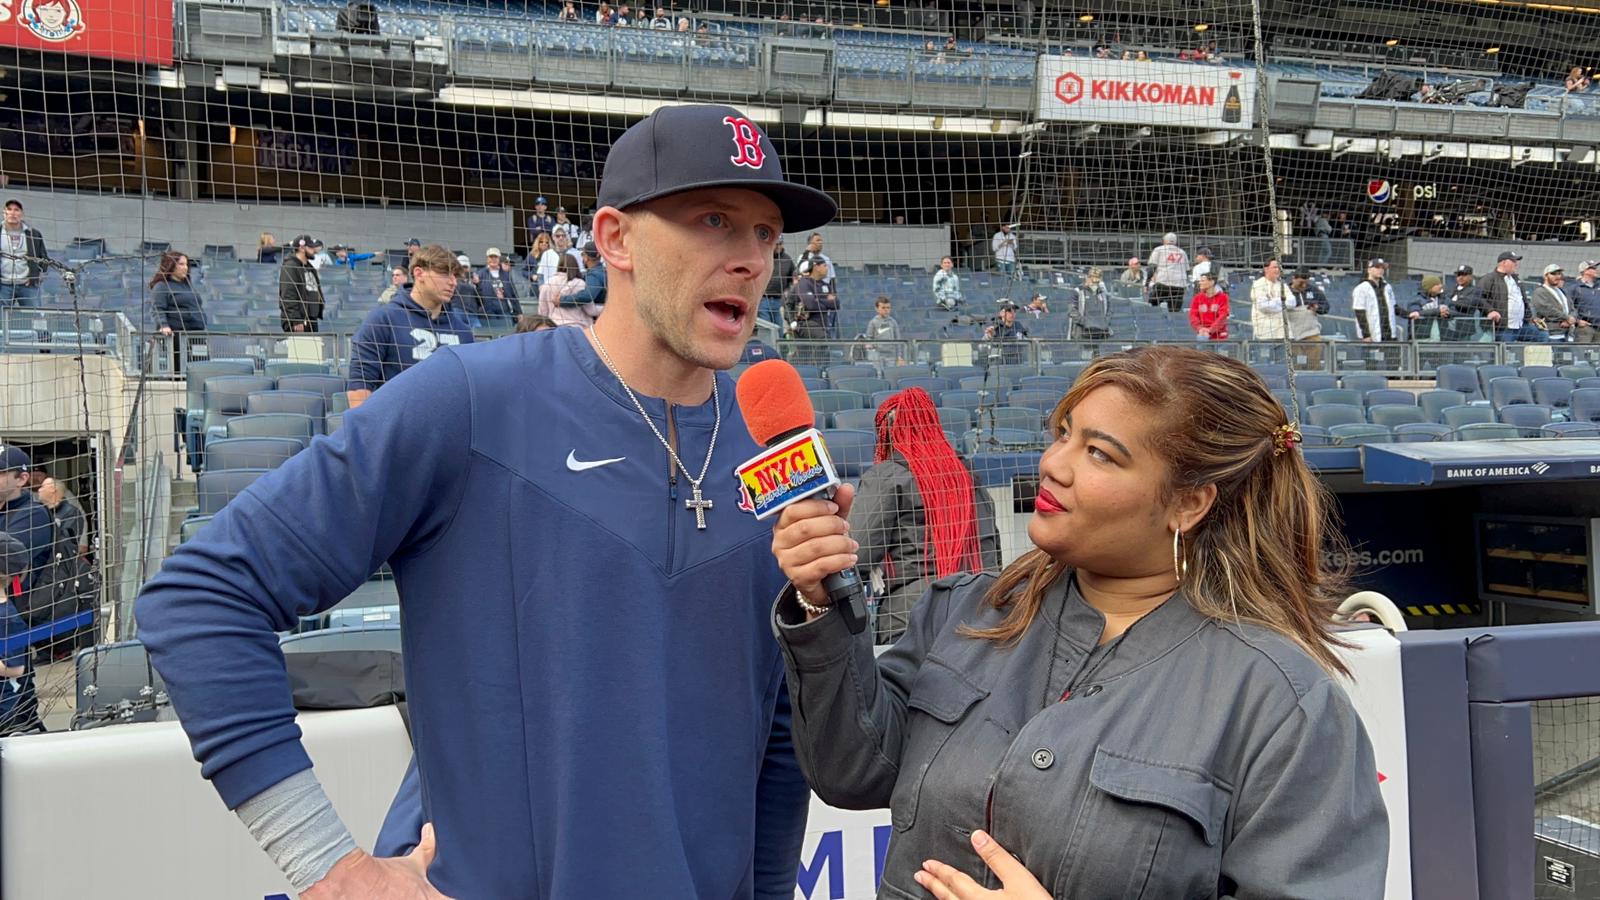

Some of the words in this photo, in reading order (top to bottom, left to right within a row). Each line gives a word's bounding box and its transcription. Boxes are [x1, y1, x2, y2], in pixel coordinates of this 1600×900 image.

[1091, 80, 1216, 106] KIKKOMAN
[723, 116, 766, 169] B
[754, 450, 811, 496] NYC
[1447, 469, 1473, 478] BANK
[1475, 468, 1487, 477] OF
[1488, 466, 1530, 476] AMERICA
[1321, 549, 1424, 567] kees.com
